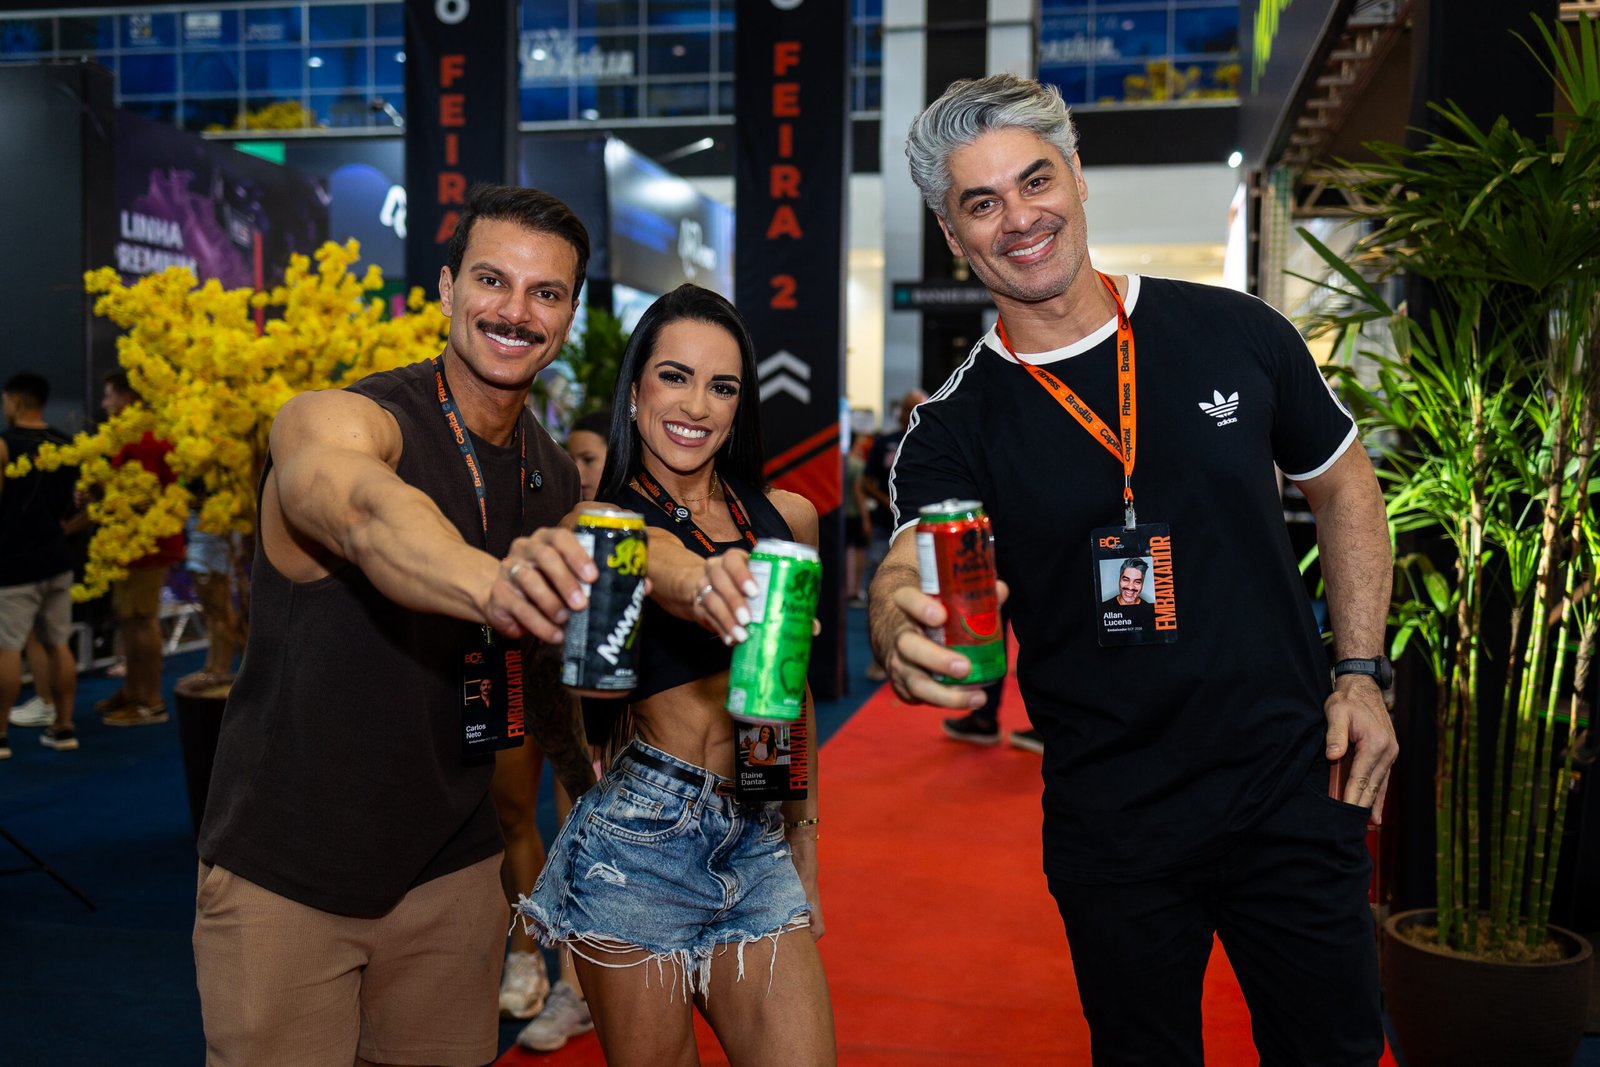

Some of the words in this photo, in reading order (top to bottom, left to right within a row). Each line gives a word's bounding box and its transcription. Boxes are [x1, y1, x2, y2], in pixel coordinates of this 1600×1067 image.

[766, 41, 802, 240] FEIRA
[121, 209, 184, 250] LINHA
[769, 274, 798, 310] 2
[436, 371, 448, 403] Fitness
[1034, 370, 1060, 391] Fitness
[1122, 382, 1130, 416] Fitness
[445, 411, 464, 444] Capital
[1217, 417, 1238, 427] adidas
[1123, 427, 1132, 462] Capital
[691, 530, 715, 553] Fitness
[1149, 535, 1177, 631] EMBAIXADOR
[1103, 619, 1132, 627] Lucena
[505, 649, 525, 738] EMBAIXADOR
[465, 723, 487, 733] Carlos
[466, 731, 482, 740] Neto
